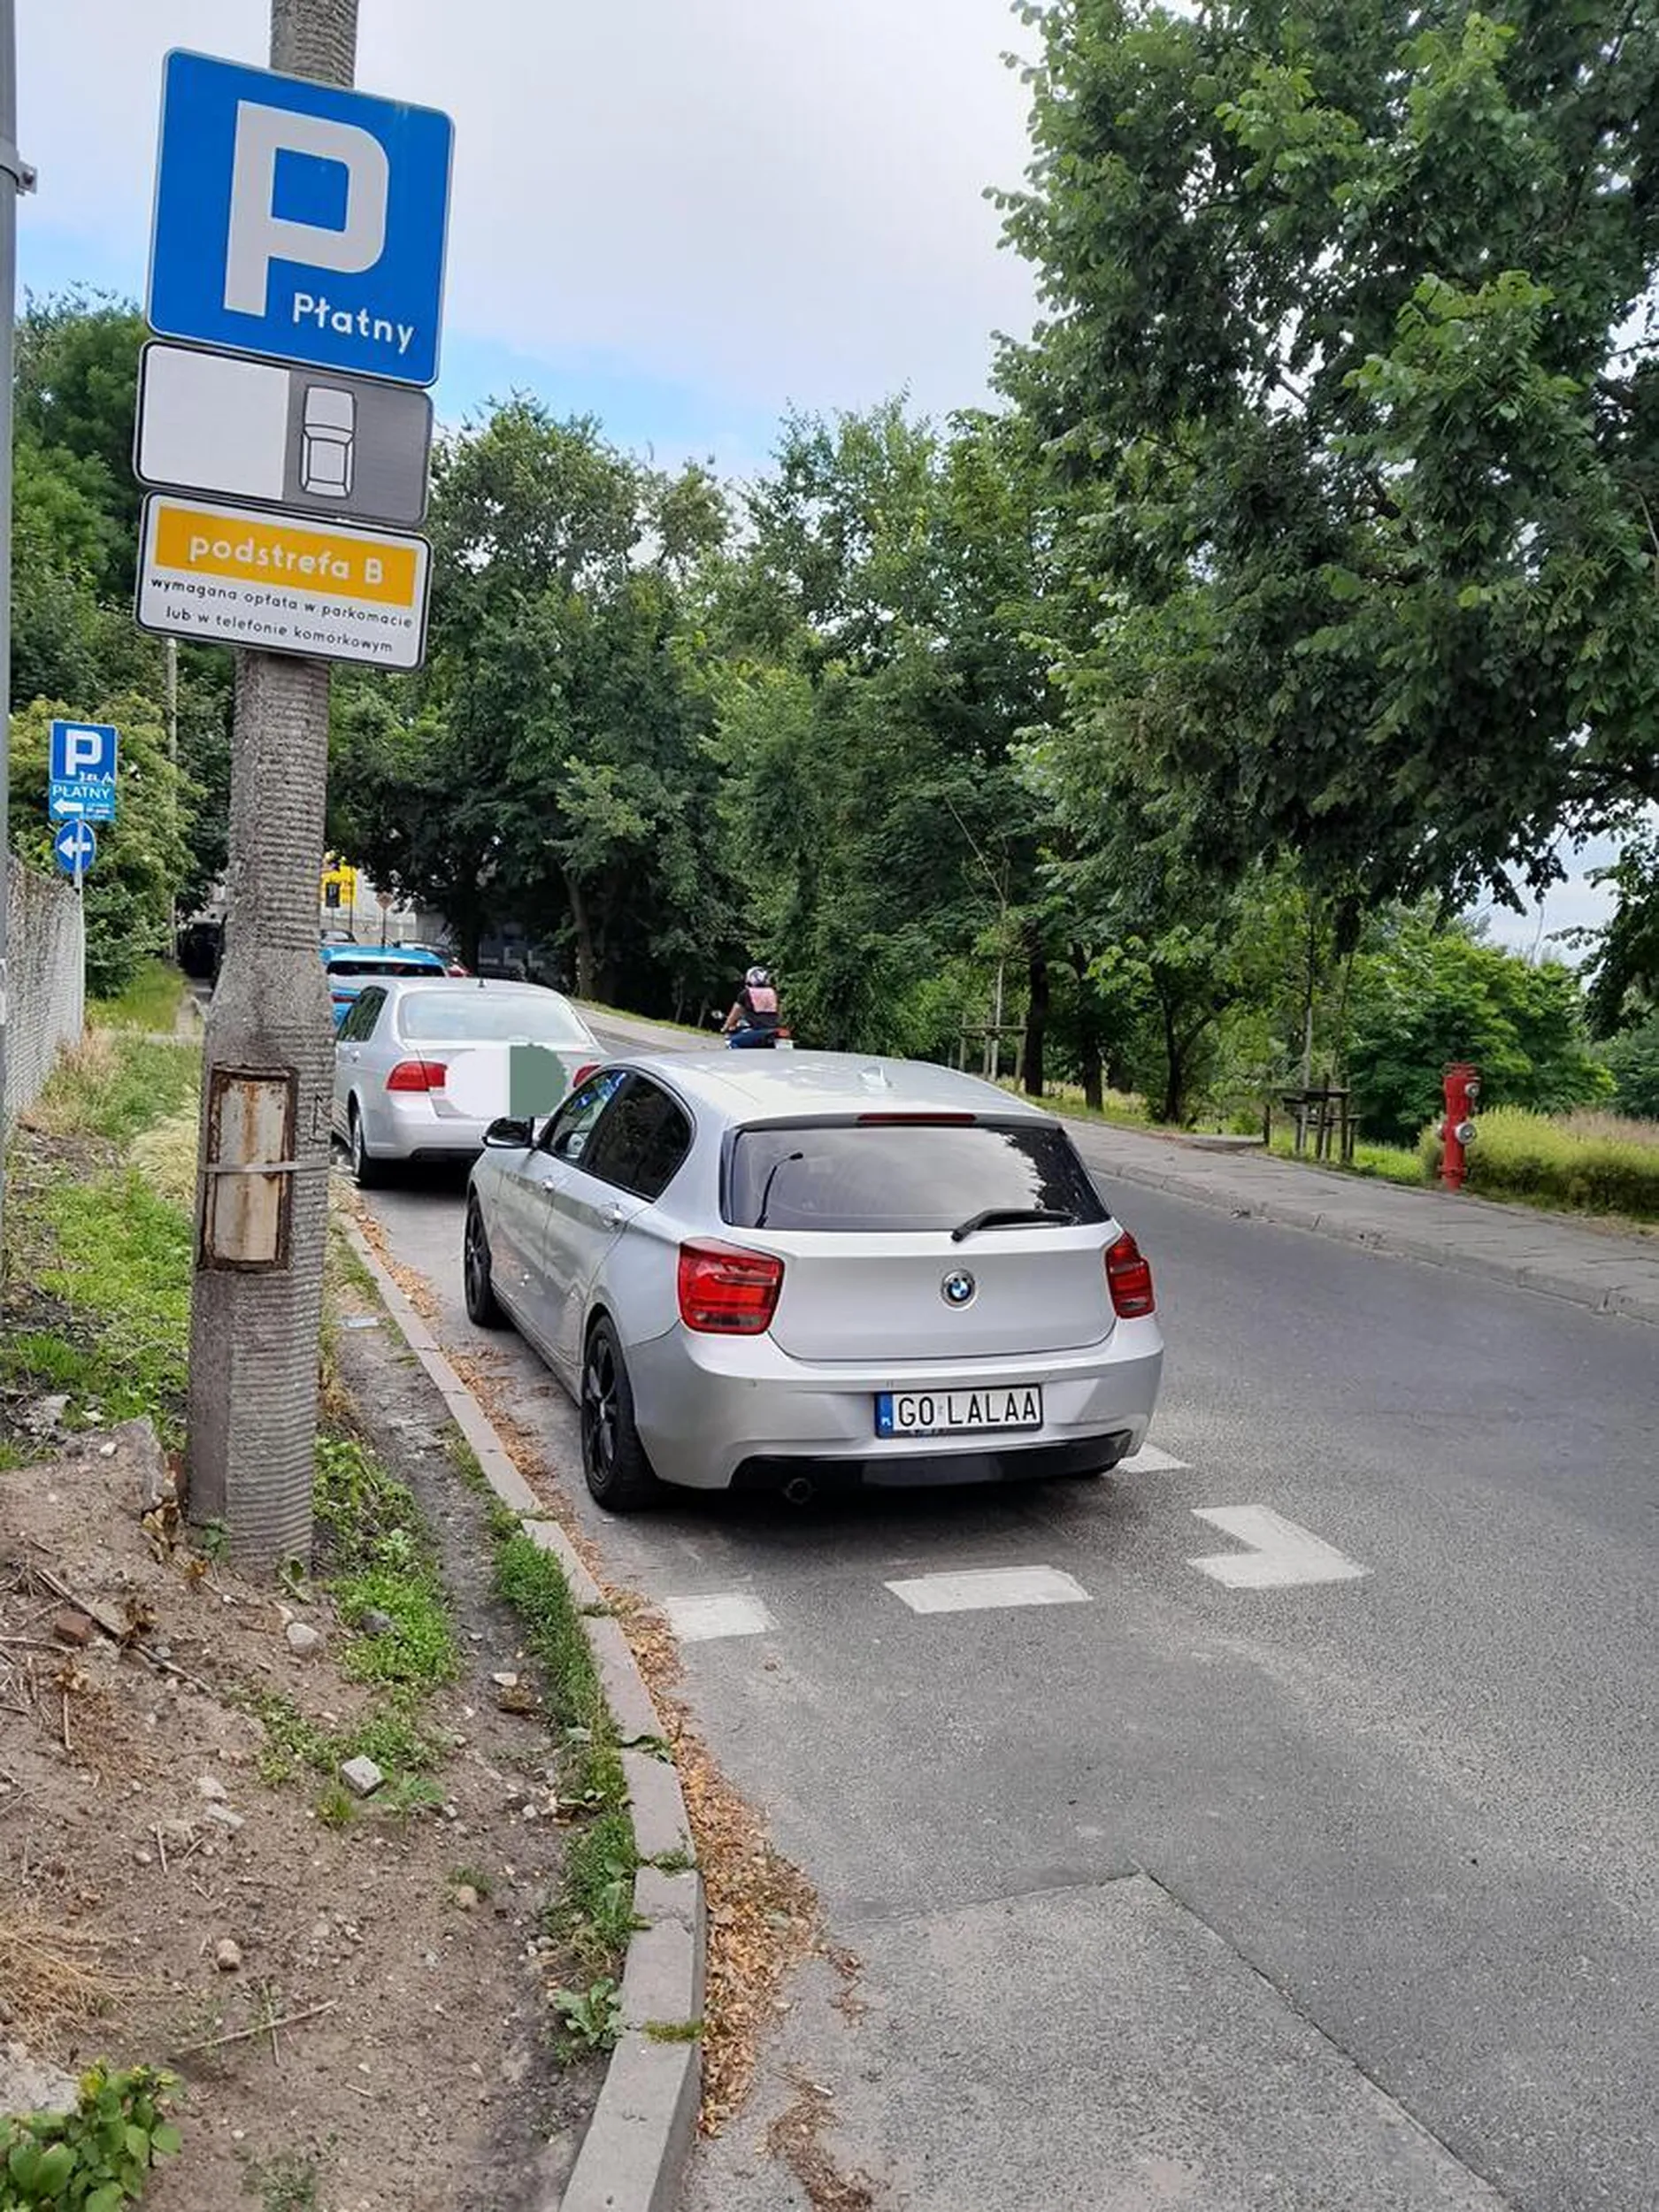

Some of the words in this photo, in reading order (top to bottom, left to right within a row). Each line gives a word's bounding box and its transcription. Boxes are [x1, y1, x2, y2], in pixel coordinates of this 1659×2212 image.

[224, 99, 389, 318] P
[293, 292, 415, 353] Płatny
[188, 535, 350, 580] podstrefa
[364, 557, 383, 584] B
[150, 578, 237, 600] wymagana
[304, 602, 316, 613] w
[321, 605, 412, 628] parkomacie
[165, 605, 191, 621] lub
[197, 613, 210, 623] w
[216, 614, 288, 636] telefonie
[65, 728, 102, 775] P
[947, 1391, 1037, 1425] LALAA
